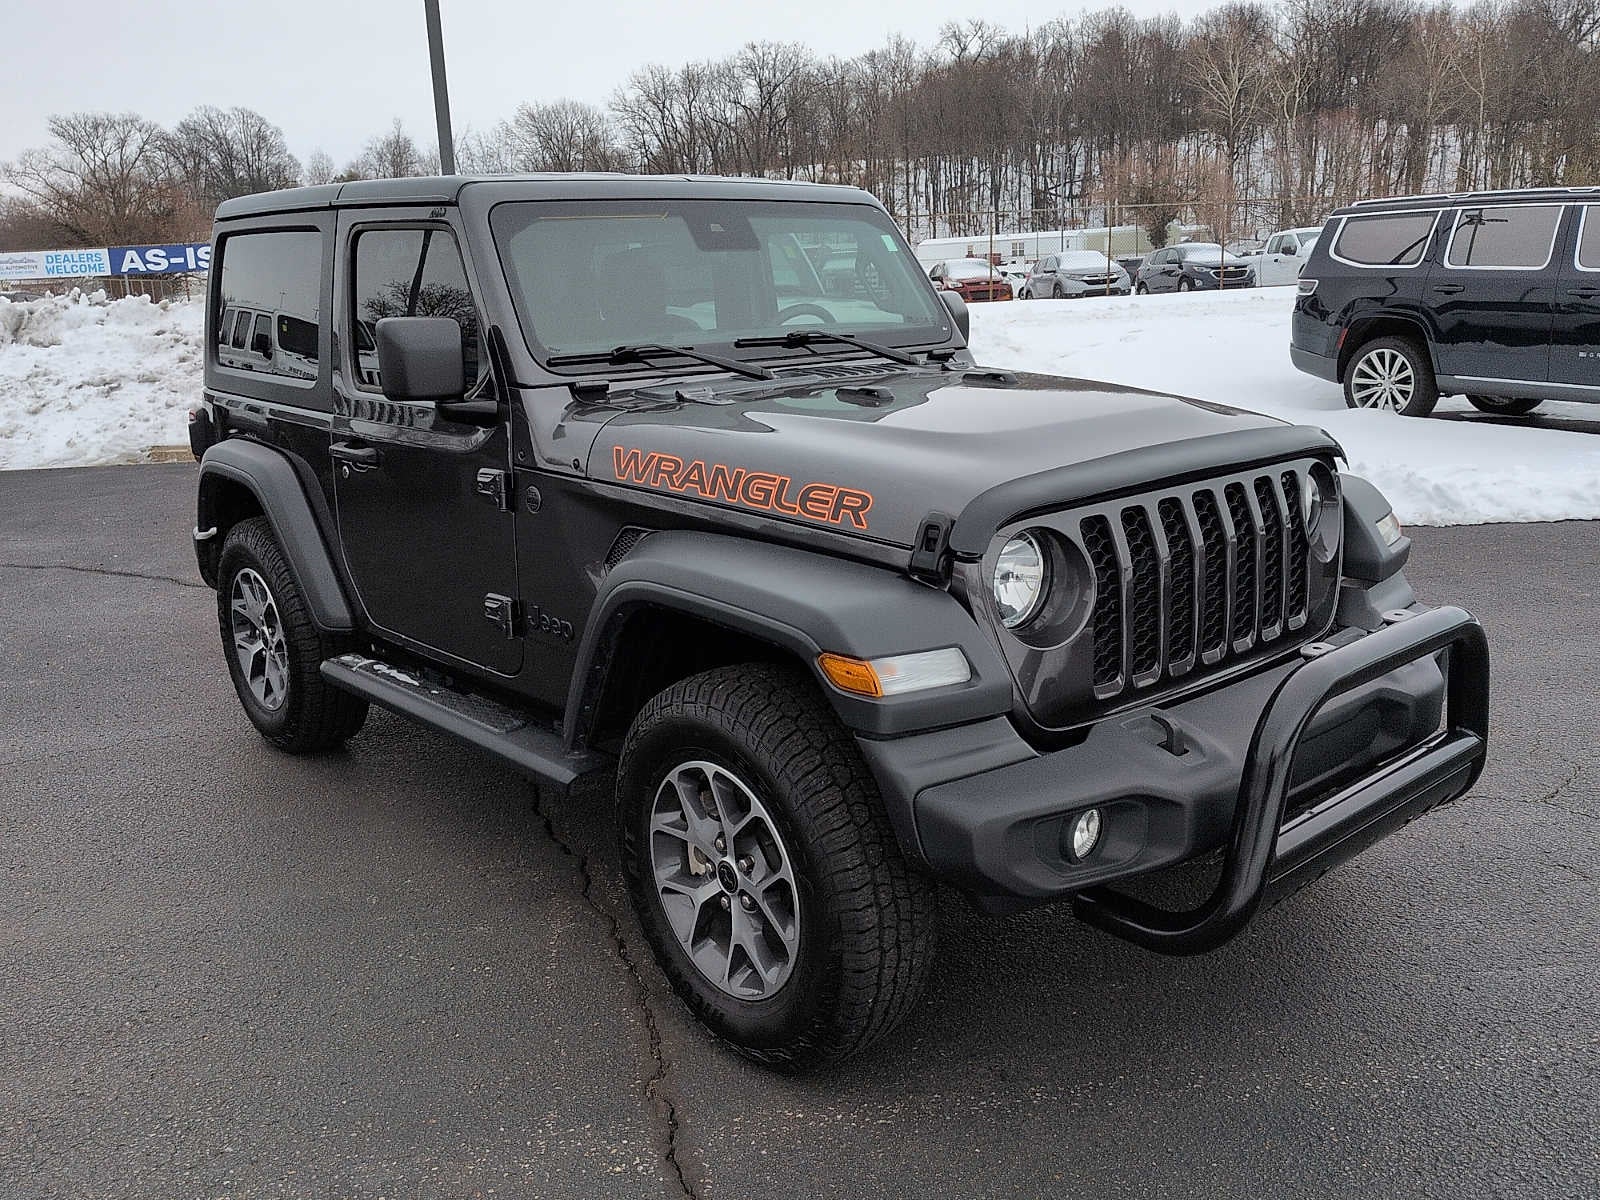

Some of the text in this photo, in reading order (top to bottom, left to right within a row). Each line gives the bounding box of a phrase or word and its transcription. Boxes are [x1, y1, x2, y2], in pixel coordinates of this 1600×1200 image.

[45, 252, 102, 264] DEALERS
[45, 262, 106, 274] WELCOME
[613, 446, 873, 530] WRANGLER
[527, 605, 575, 641] Jeep
